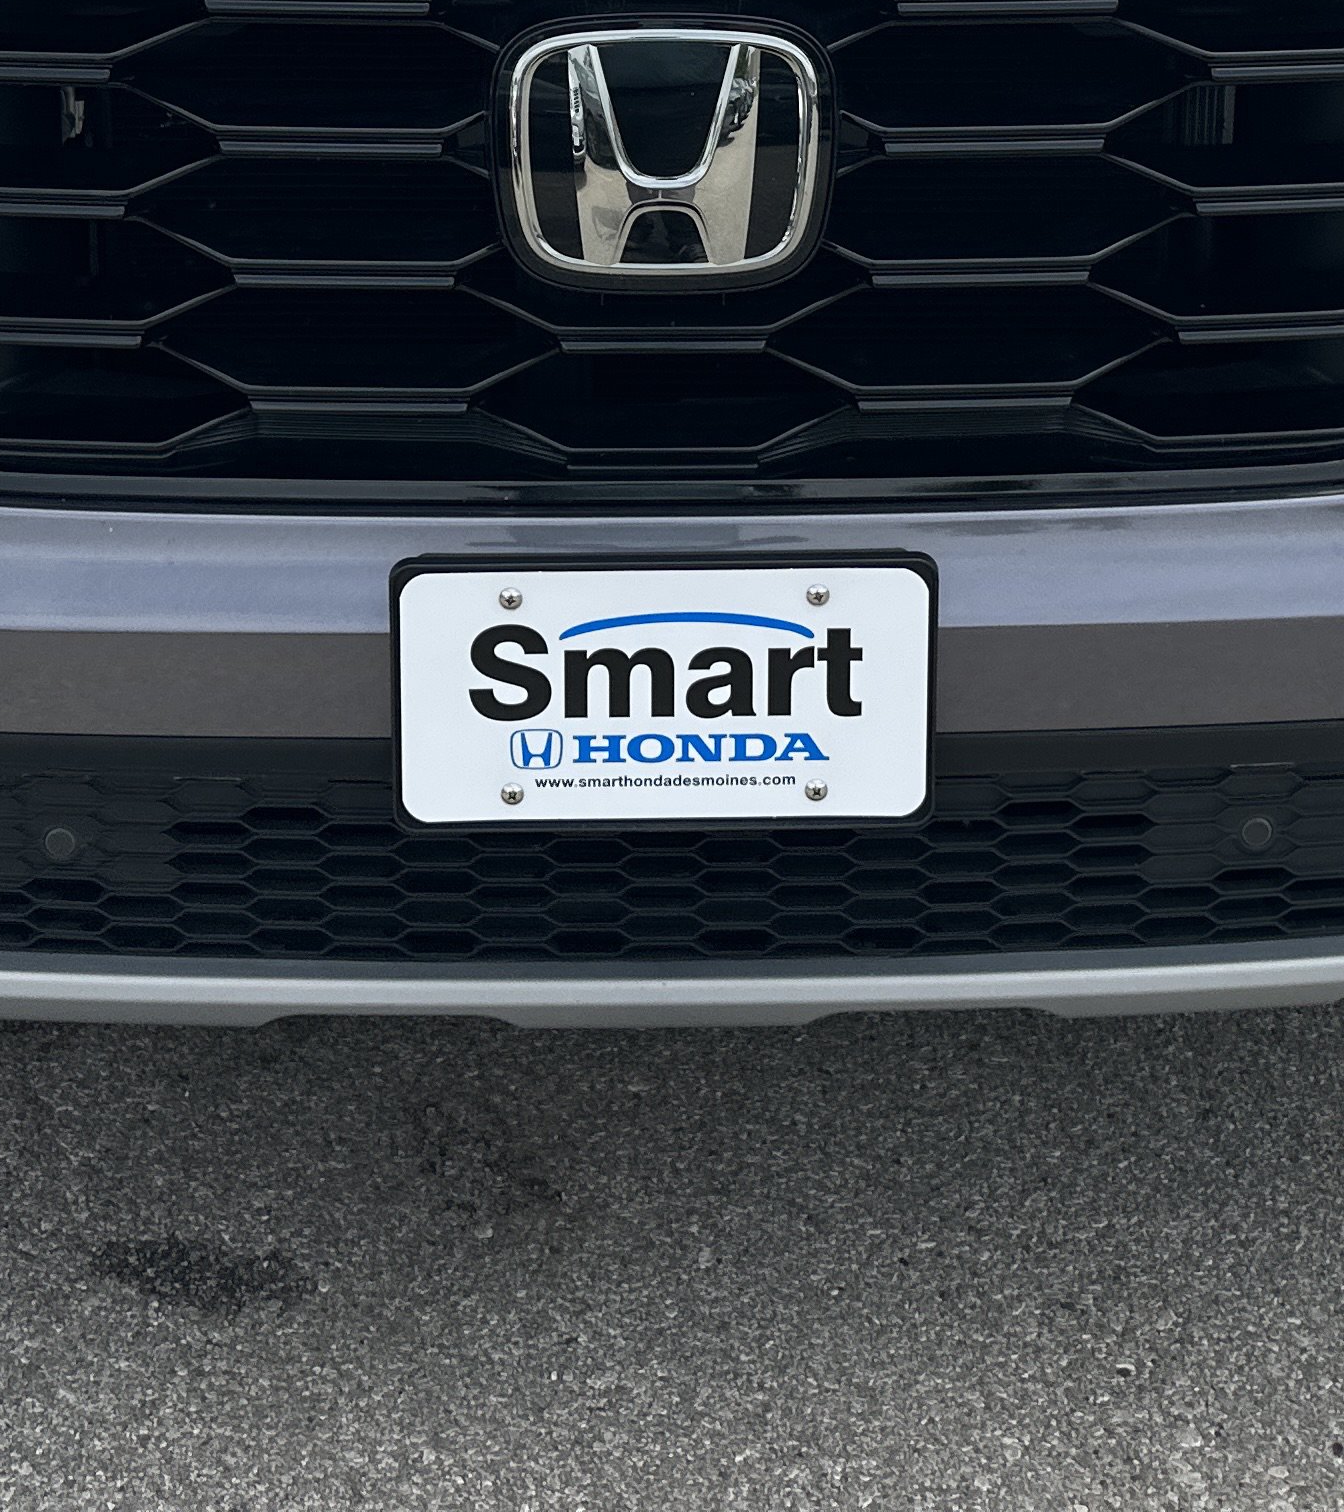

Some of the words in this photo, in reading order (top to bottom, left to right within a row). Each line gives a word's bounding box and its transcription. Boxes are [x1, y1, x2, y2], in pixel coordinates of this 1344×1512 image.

[468, 623, 863, 721] Smart
[573, 732, 829, 765] HONDA
[535, 774, 797, 789] www.smarthondadesmoines.com
